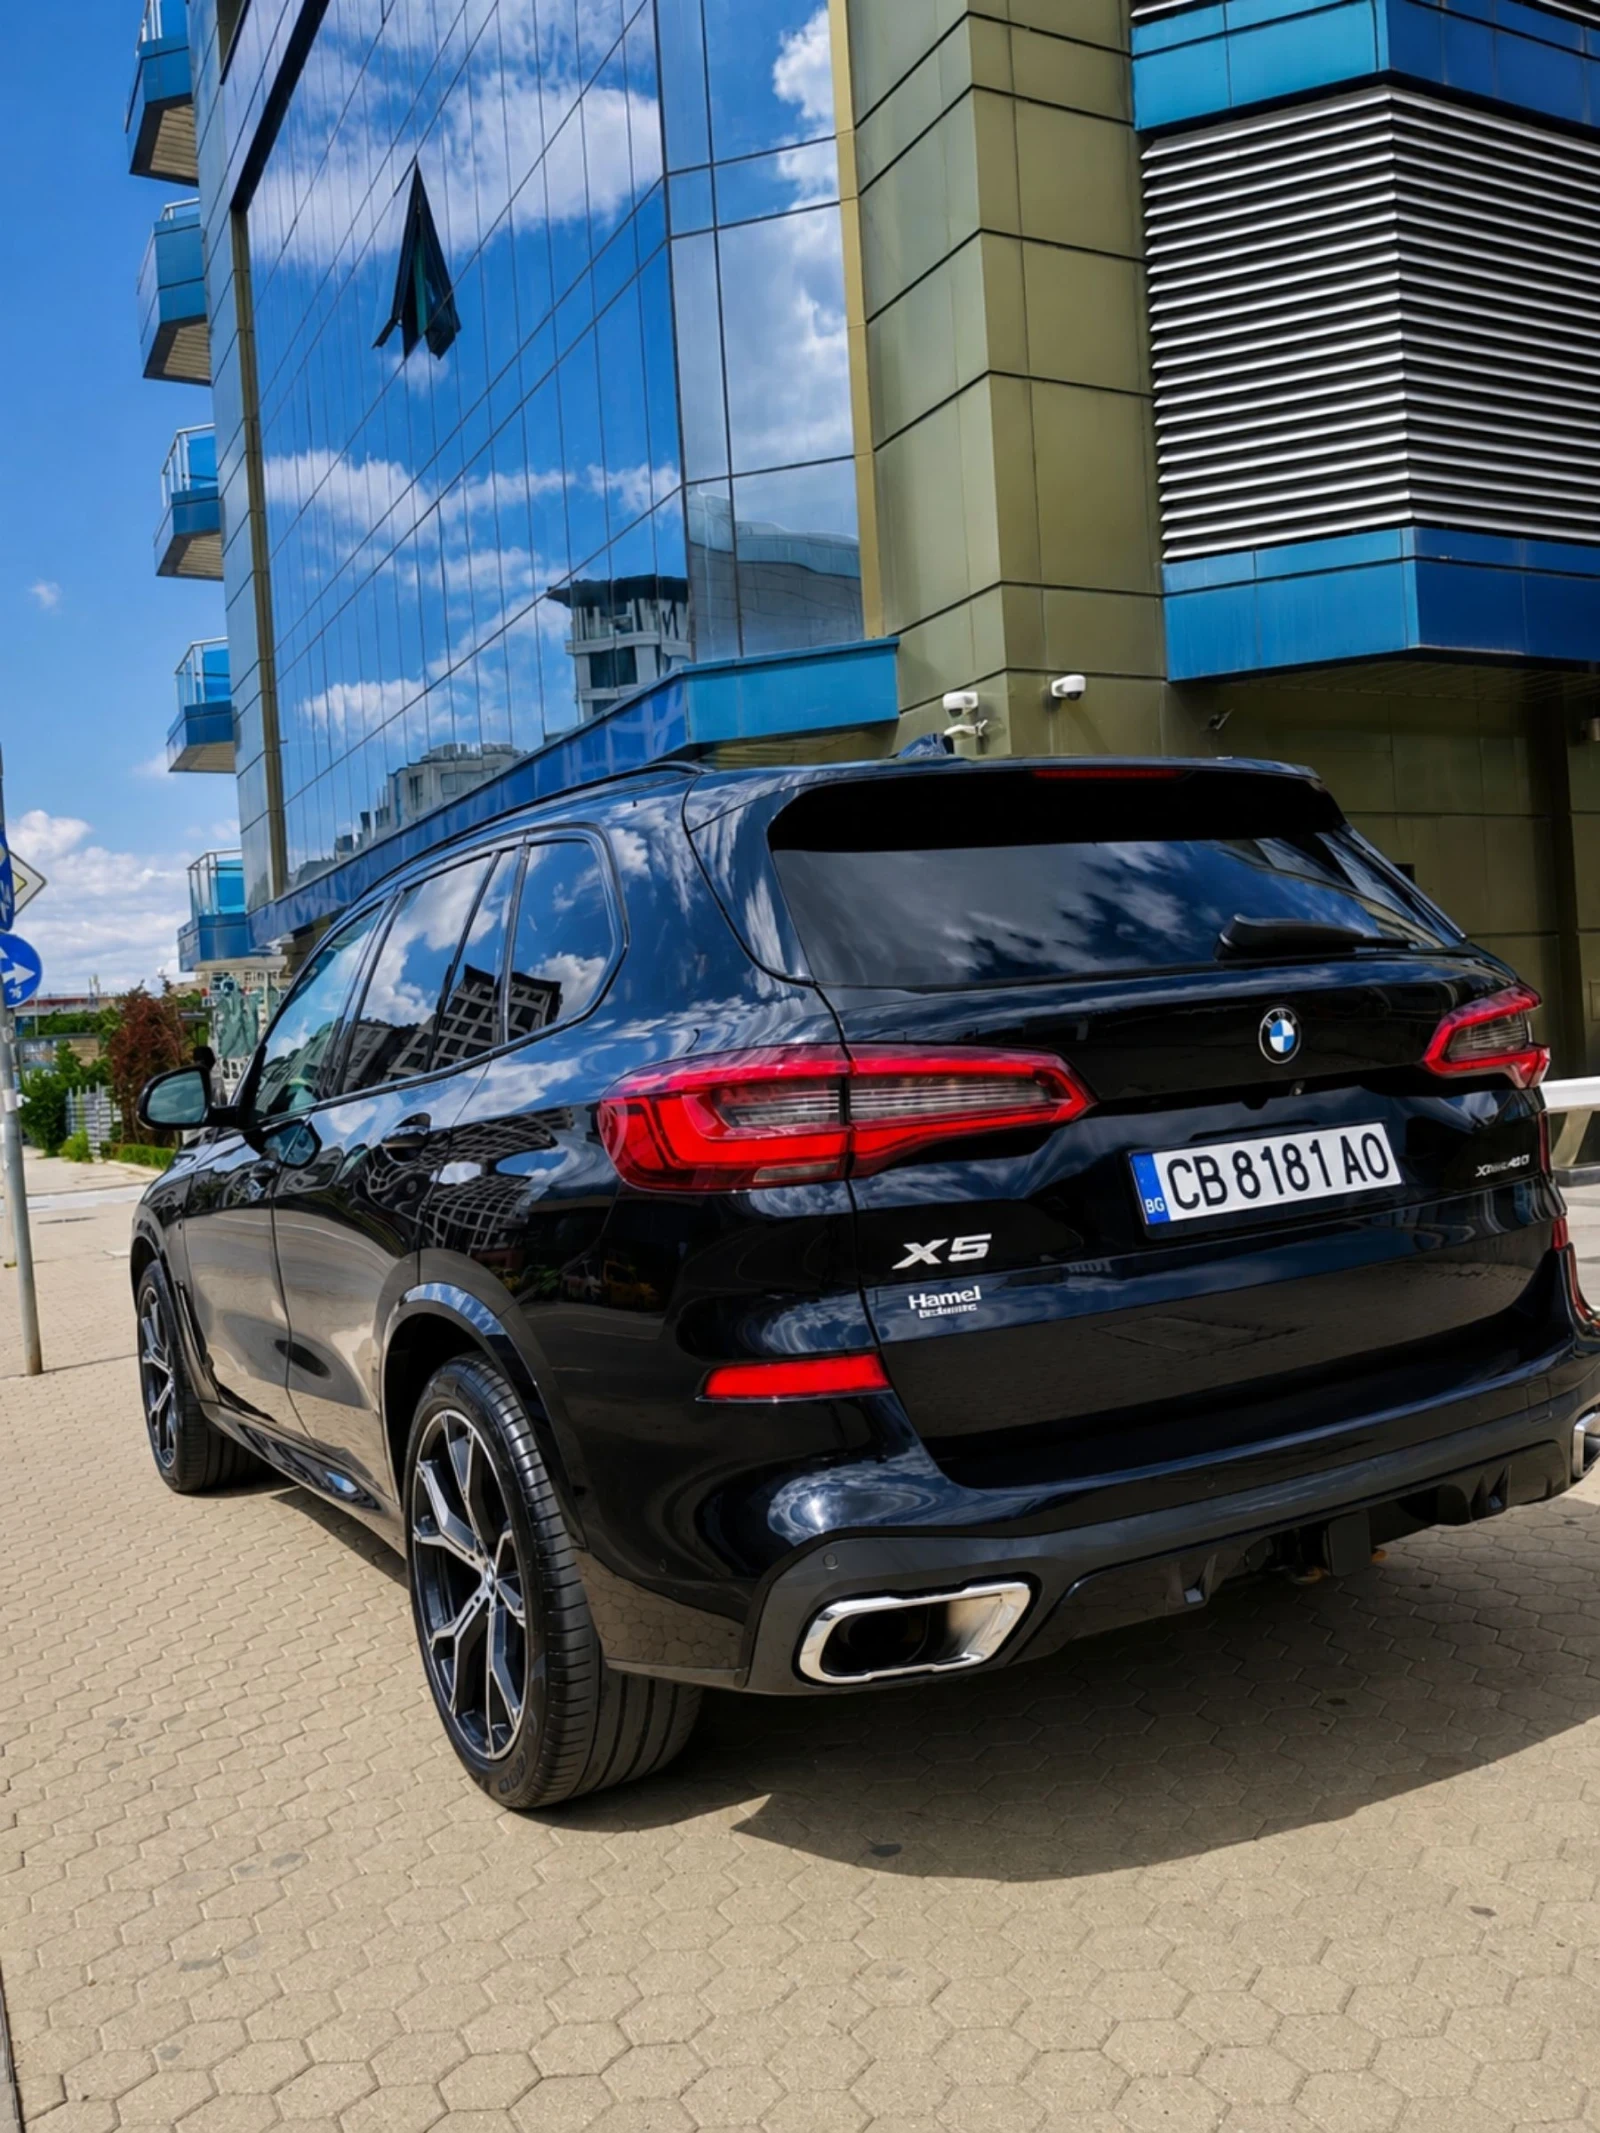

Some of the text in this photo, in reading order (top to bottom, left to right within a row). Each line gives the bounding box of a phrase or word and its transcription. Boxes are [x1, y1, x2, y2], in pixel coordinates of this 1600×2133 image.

[1167, 1131, 1390, 1210] CB 8181 AO
[1144, 1196, 1166, 1215] BG
[891, 1233, 992, 1270] X5
[908, 1285, 982, 1310] Hamel
